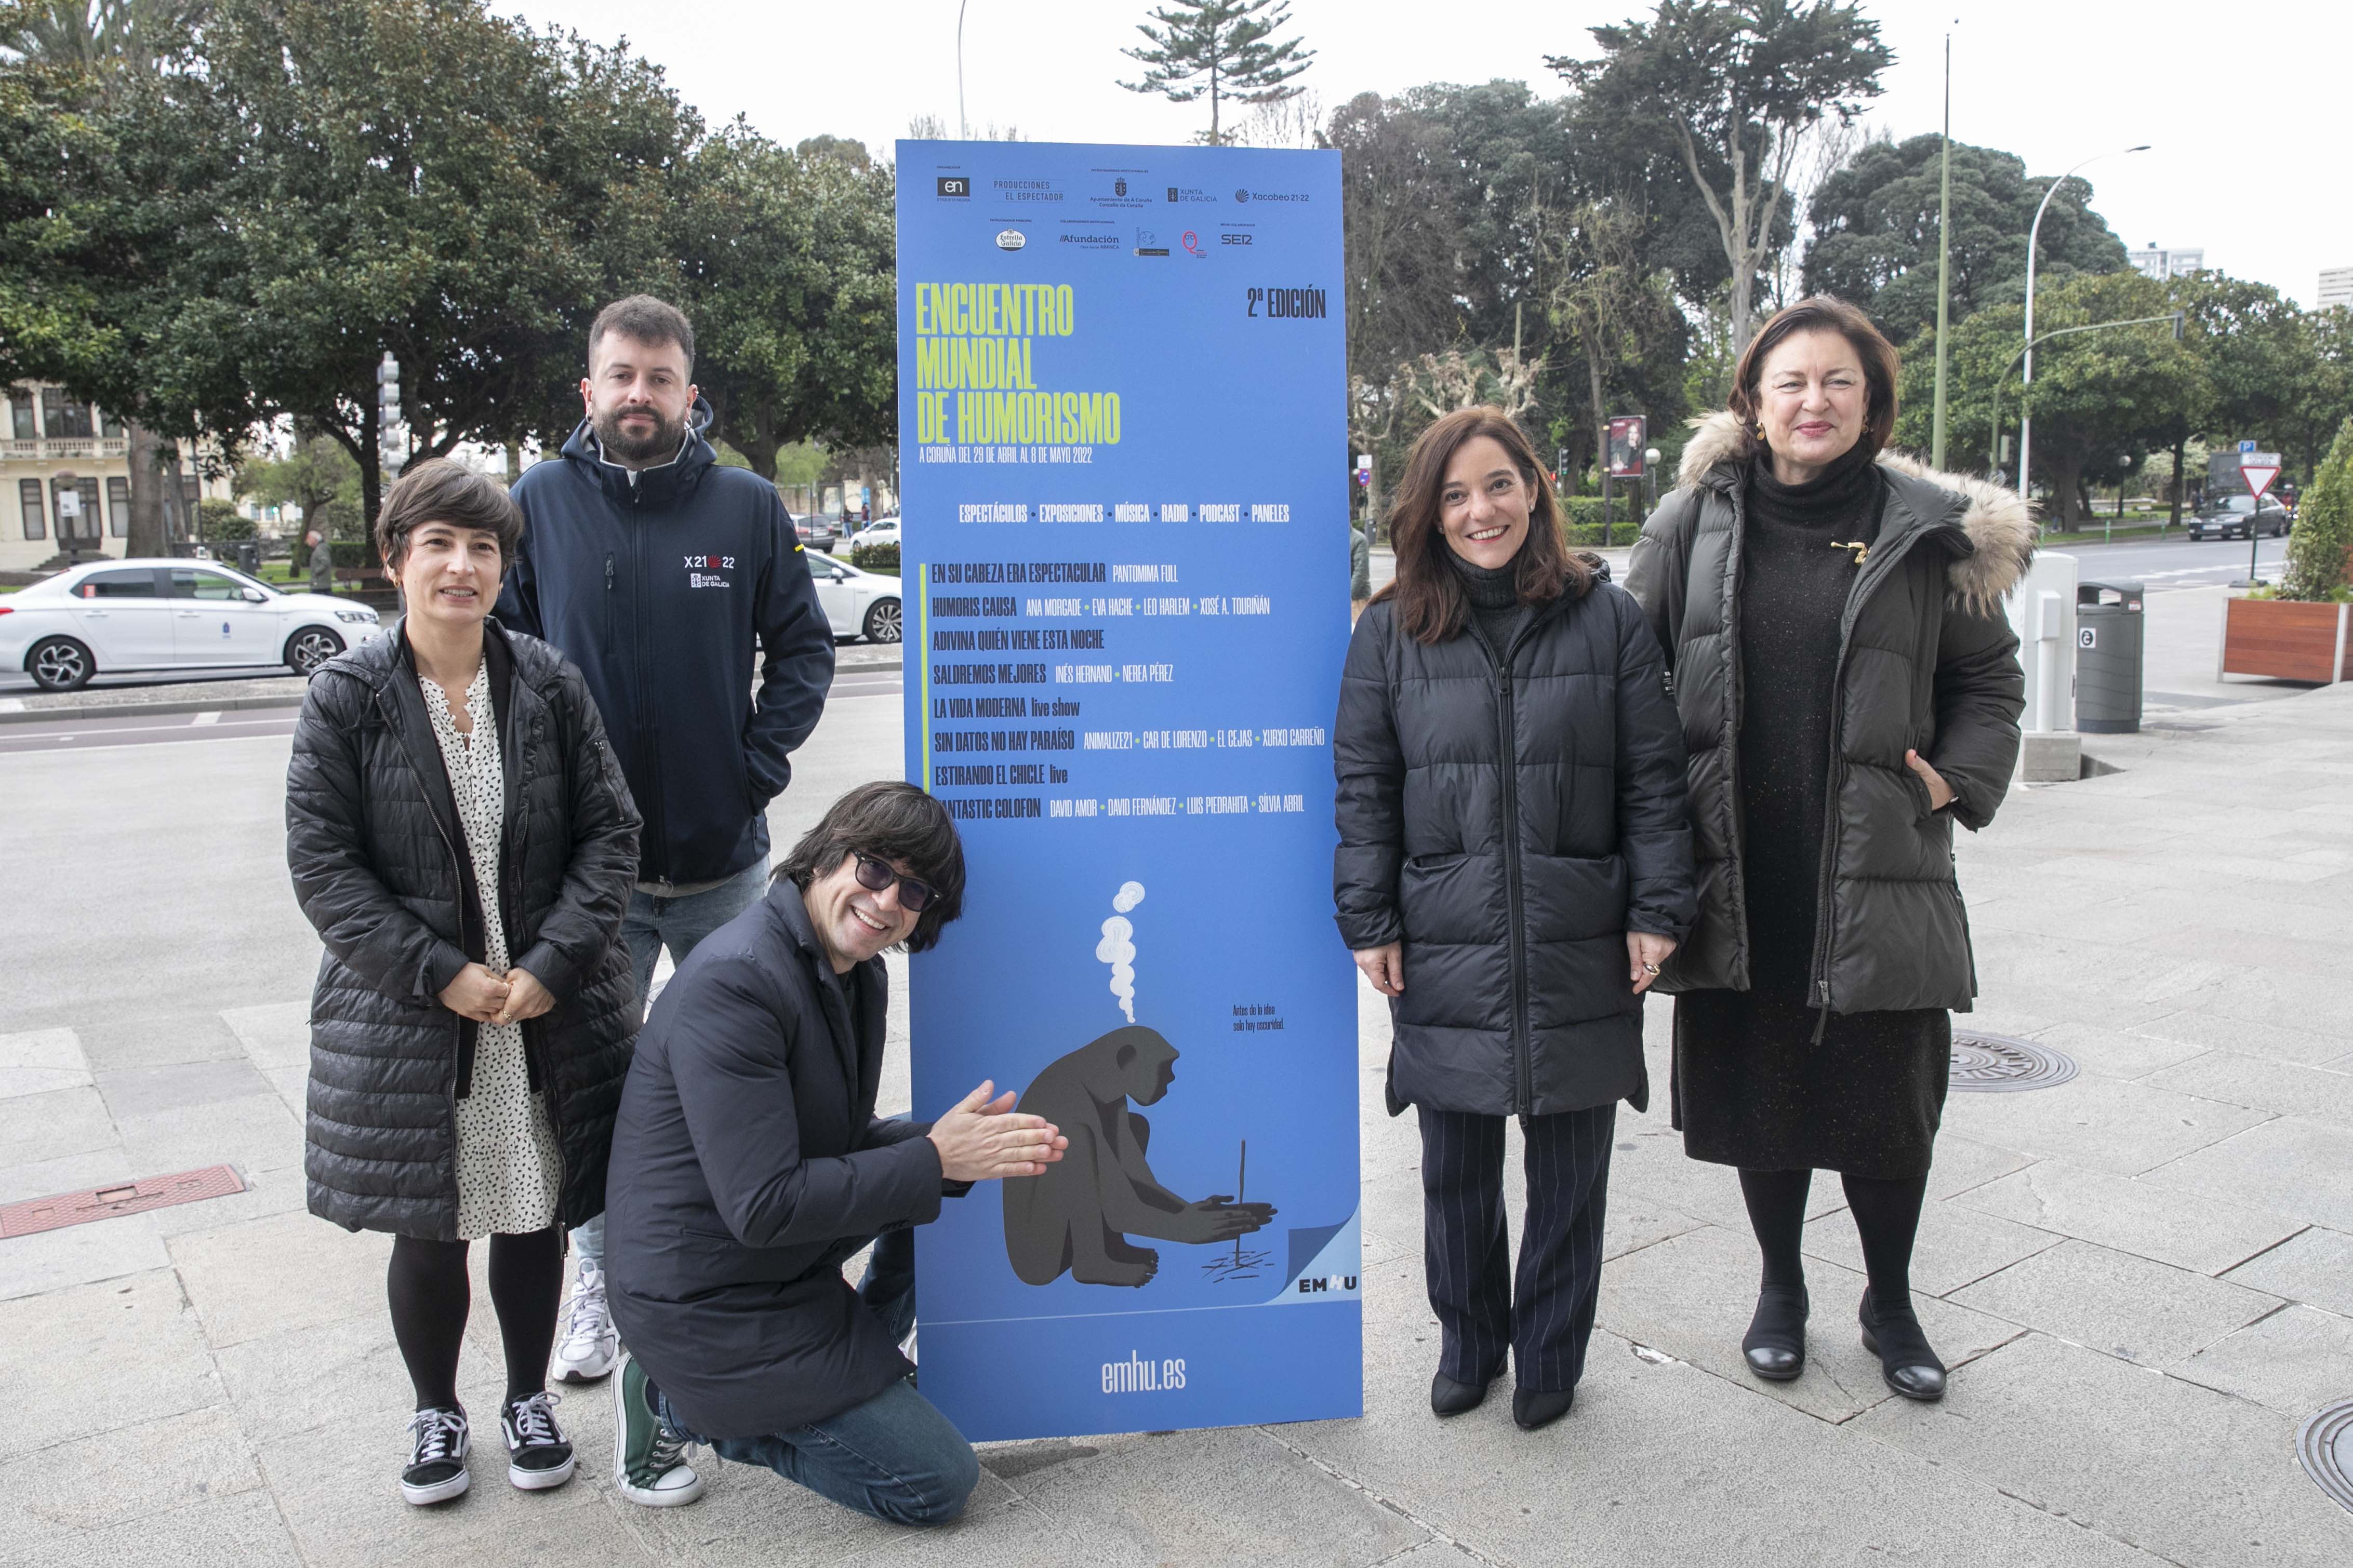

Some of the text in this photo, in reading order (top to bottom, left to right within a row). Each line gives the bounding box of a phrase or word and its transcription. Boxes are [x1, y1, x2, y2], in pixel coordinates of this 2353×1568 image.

[994, 181, 1050, 189] PRODUCCIONES
[1018, 193, 1063, 201] ESPECTADOR
[1252, 193, 1289, 201] Xacobeo
[1221, 234, 1252, 245] SER
[916, 283, 1073, 336] ENCUENTRO
[1248, 284, 1326, 318] 2ª EDICIÓN
[916, 337, 1037, 389] MUNDIAL
[917, 392, 1121, 445] DE HUMORISMO
[919, 445, 1092, 463] A CORUÑA DEL 29 DE ABRIL AL 8 DE MAYO 2022
[960, 501, 1289, 522] ESPECTÁCULOS EXPOSICIONES MÚSICA RADIO PODCAST PANELES
[932, 563, 1178, 583] EN SU CABEZA ERA ESPECTACULAR PANTOMIMA FULL
[933, 595, 1269, 617] HUMORIS CAUSA ANA MORGADE EVA HACHE LEO HARLEM XOSÉ A. TOURIÑÁN
[934, 627, 1104, 651] ADIVINA QUIÉN VIENE ESTA NOCHE
[934, 662, 1173, 685] SALDREMOS MEJORES INÉS HERNAND NEREA PÉREZ
[934, 697, 1080, 718] LA VIDA MODERNA live show
[935, 727, 1324, 752] SIN DATOS NO HAY PARAÍSO ANIMALIZE21 CAR DE LORENZO EL CEJAS XURXO CARREÑO
[936, 764, 1068, 786] ESTIRANDO EL CHICLE live
[940, 793, 1304, 820] ANTASTIC COLOFON DAVID AMOR DAVID FERNÁNDEZ LUIS PIEDRAHITA SÍLVIA ABRIL
[1233, 1003, 1275, 1016] Antes de la idea
[1233, 1018, 1284, 1033] solo hay oscuridad.
[1299, 1274, 1357, 1293] EMHU
[1102, 1349, 1186, 1393] emhu.es
